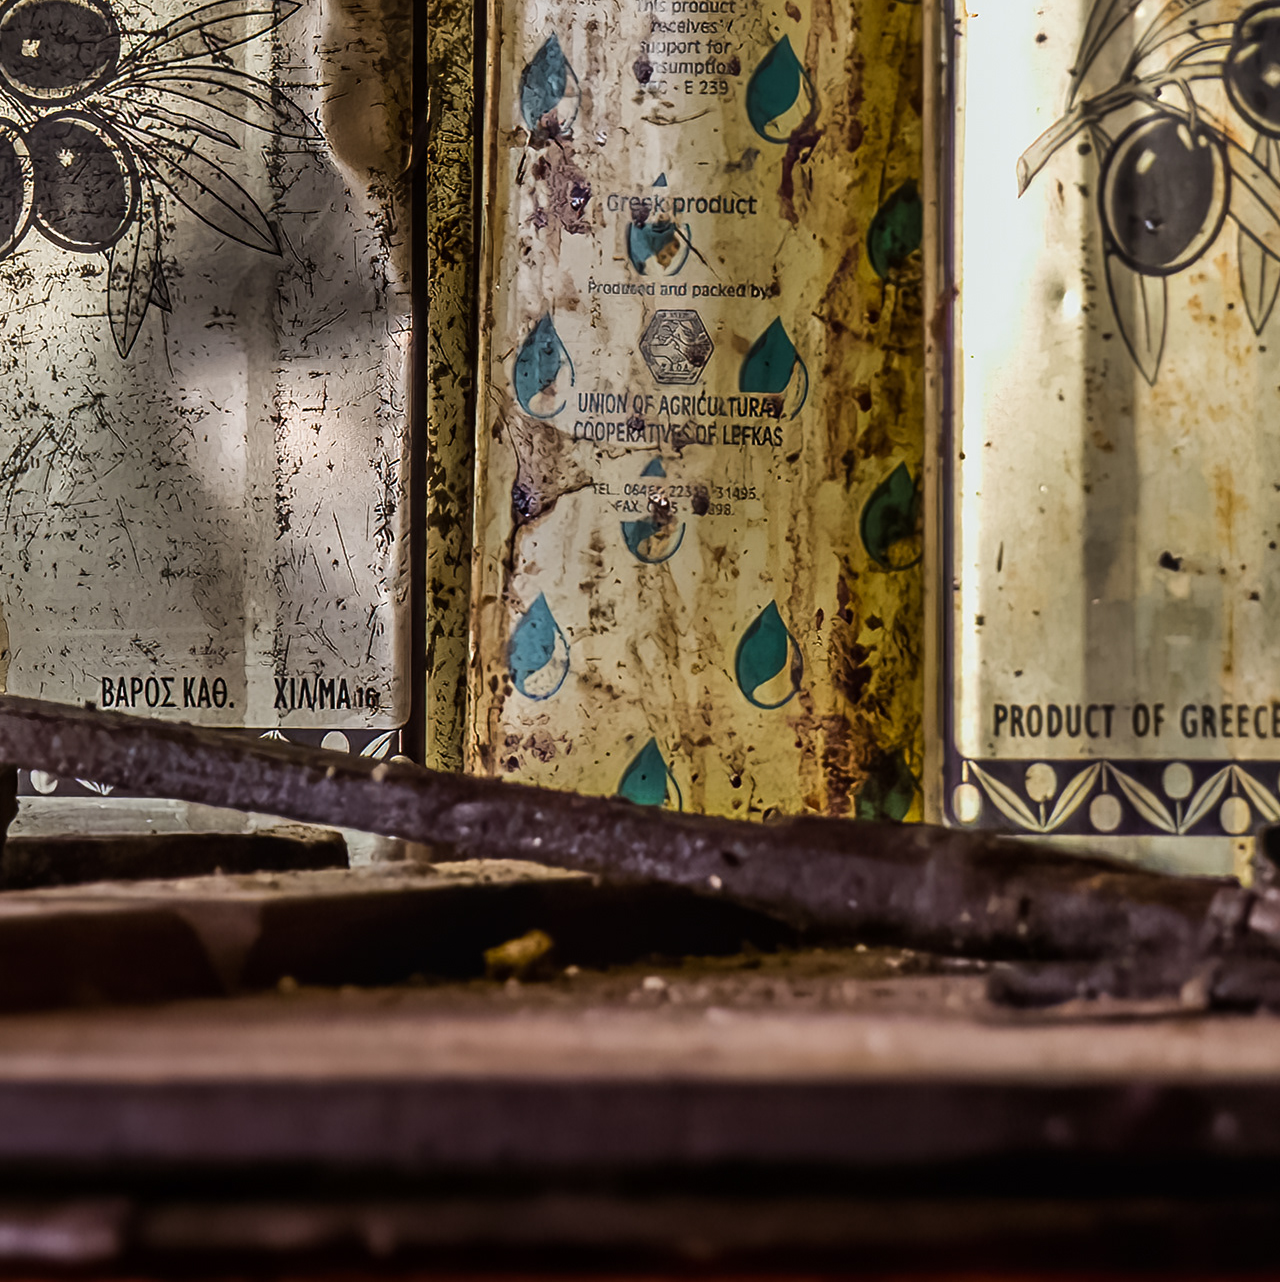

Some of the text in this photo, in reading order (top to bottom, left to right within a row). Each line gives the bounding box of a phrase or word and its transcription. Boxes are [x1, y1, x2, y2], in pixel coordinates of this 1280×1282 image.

[671, 0, 737, 15] product
[651, 19, 718, 34] receives
[639, 38, 733, 56] support for
[683, 79, 694, 95] E
[699, 79, 729, 96] 239
[606, 193, 758, 217] Greek product
[659, 282, 688, 297] and
[692, 283, 748, 300] packed
[577, 392, 780, 418] UNION OF AGRICULTURA
[101, 675, 178, 708] ΒΑΡΟΣ
[183, 676, 235, 709] ΚΑΘ.
[992, 701, 1116, 740] PRODUCT
[1132, 703, 1167, 738] OF
